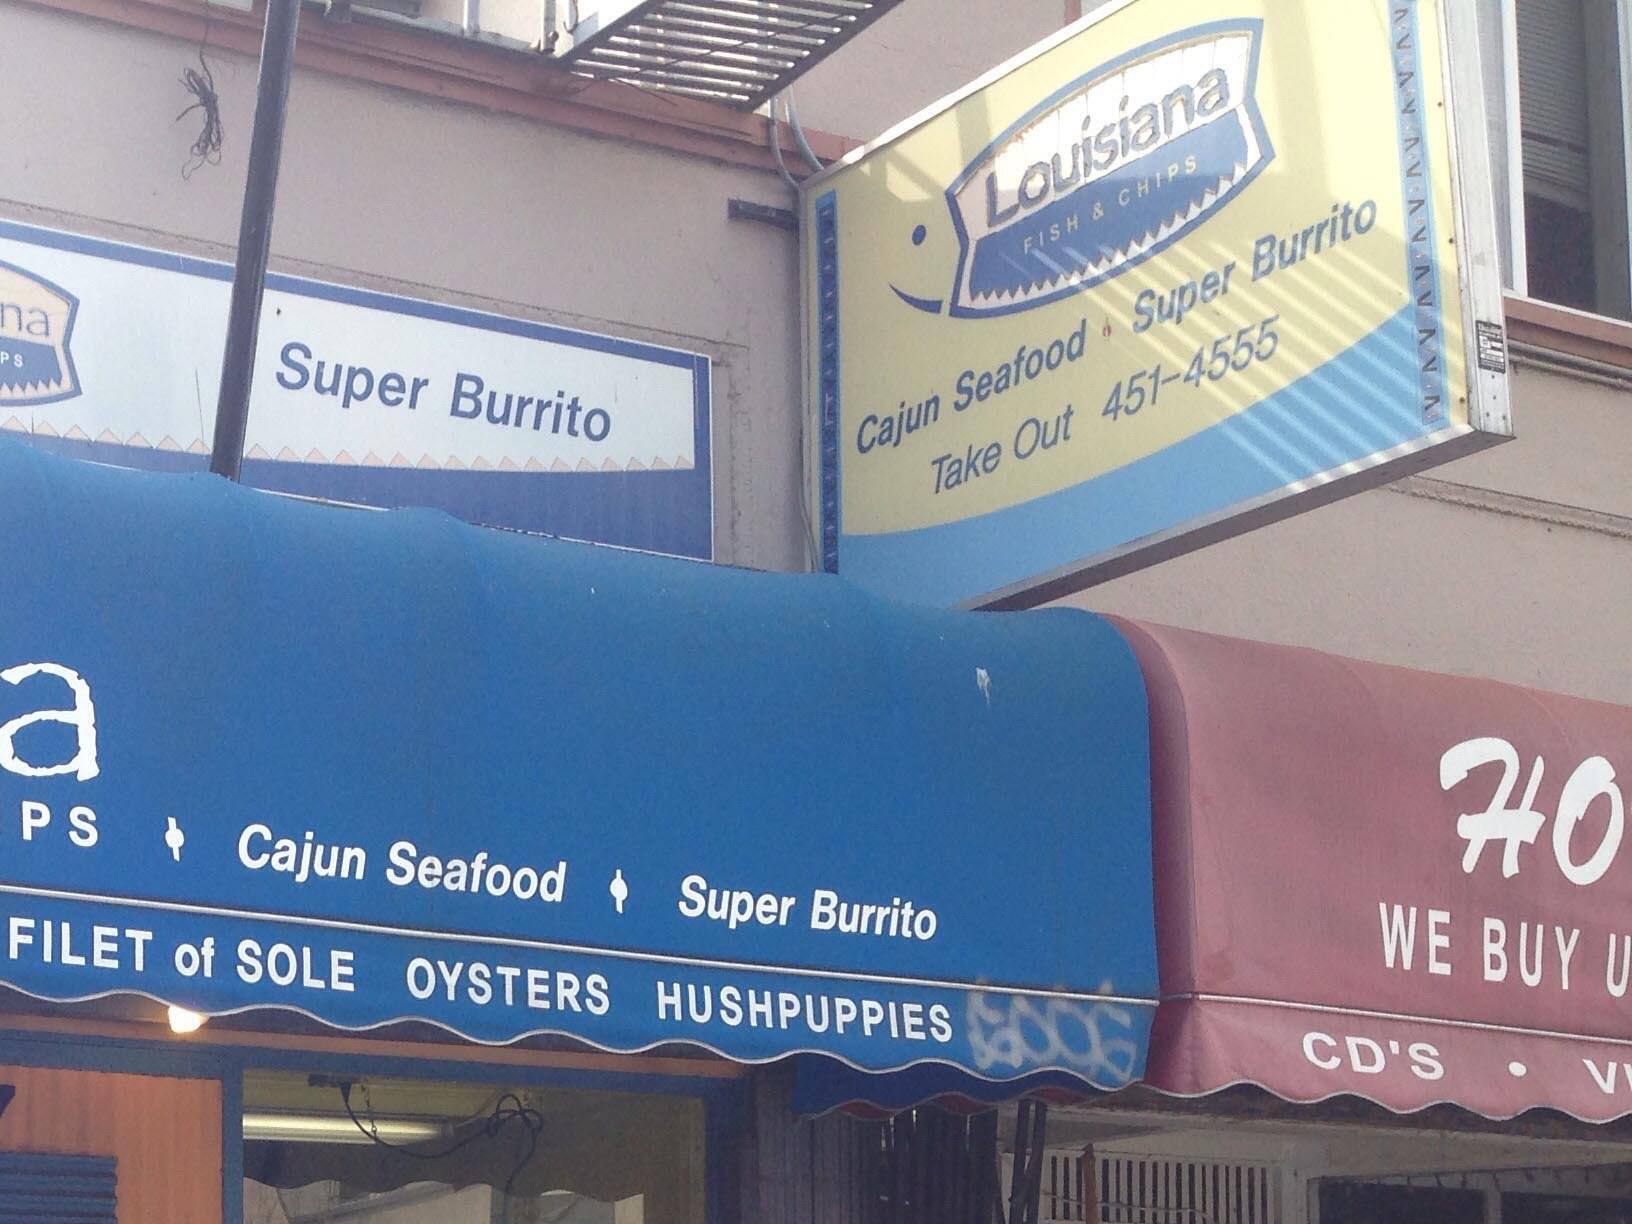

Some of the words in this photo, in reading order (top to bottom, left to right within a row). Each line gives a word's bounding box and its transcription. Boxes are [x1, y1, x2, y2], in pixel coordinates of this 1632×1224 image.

[985, 66, 1230, 227] Louisiana
[1023, 213, 1080, 256] FISH
[1092, 205, 1105, 223] &
[1117, 154, 1199, 209] CHIPS
[856, 393, 941, 456] Cajun
[954, 319, 1087, 414] Seafood
[1132, 262, 1236, 335] Super
[1250, 197, 1379, 284] Burrito
[275, 340, 431, 414] Super
[449, 374, 611, 443] Burrito
[931, 443, 1001, 497] Take
[1013, 403, 1076, 456] Out
[1102, 314, 1282, 423] 451-4555
[1439, 736, 1632, 886] HO
[238, 823, 366, 883] Cajun
[386, 841, 566, 904] Seafood
[678, 874, 795, 929] Super
[811, 888, 938, 942] Burrito
[9, 916, 153, 972] FILET
[174, 936, 215, 979] of
[236, 940, 356, 993] SOLE
[406, 957, 611, 1016] OYSTERS
[656, 980, 953, 1044] HUSHPUPPIES
[1379, 901, 1451, 976] WE
[1483, 917, 1580, 991] BUY
[1302, 1031, 1445, 1081] CD'S
